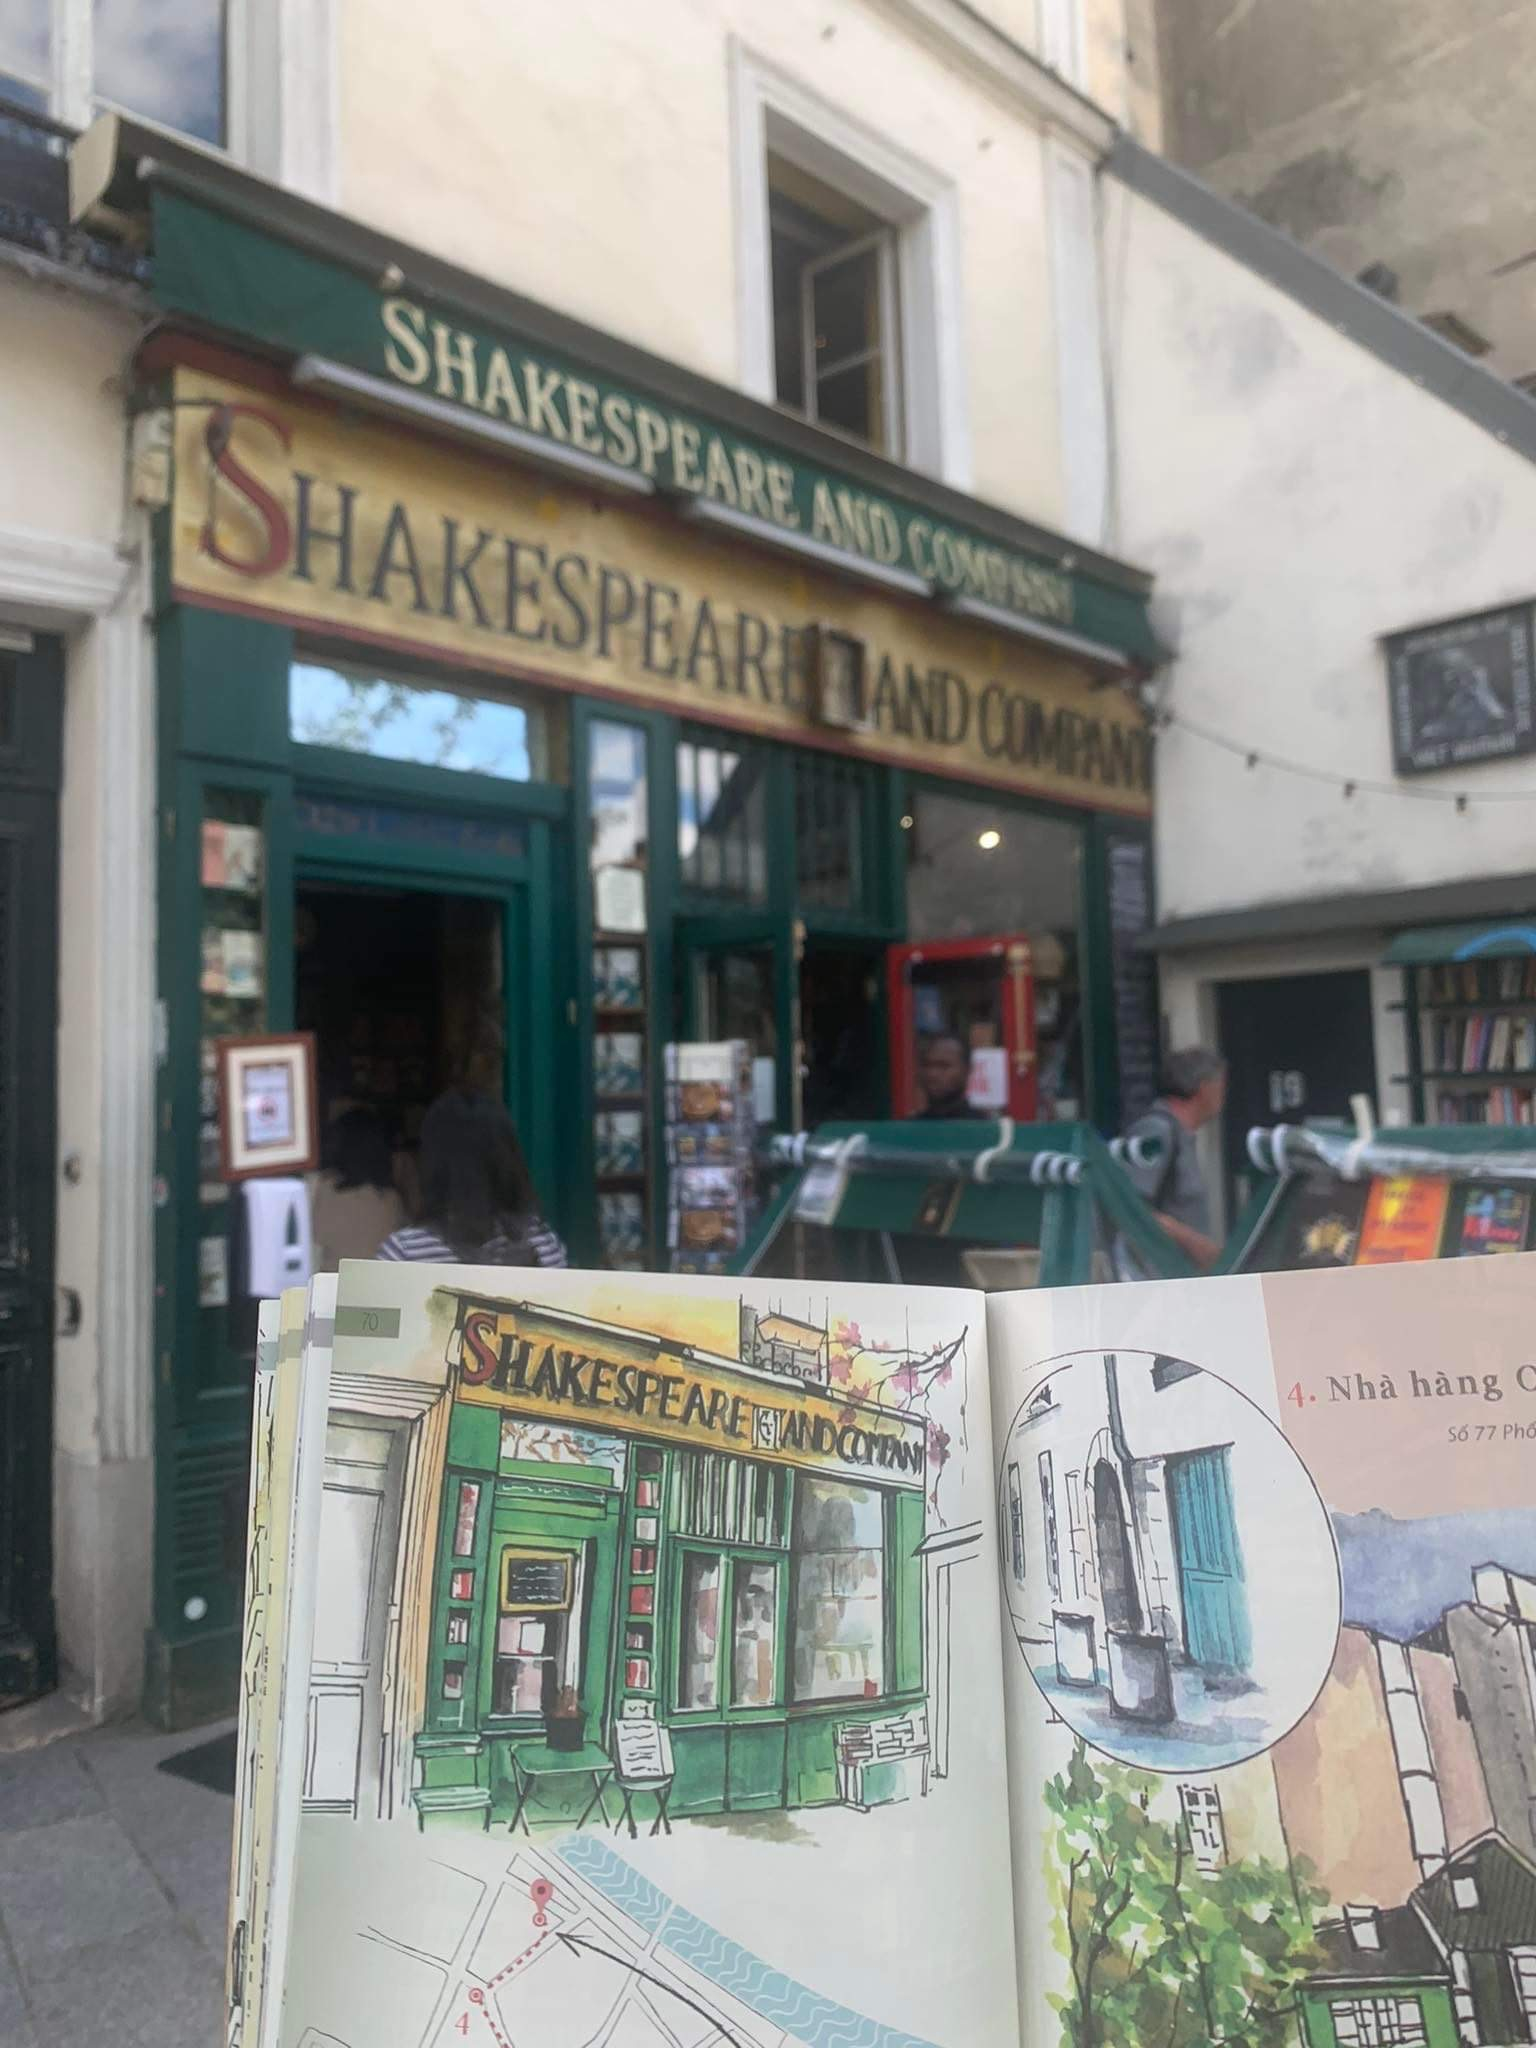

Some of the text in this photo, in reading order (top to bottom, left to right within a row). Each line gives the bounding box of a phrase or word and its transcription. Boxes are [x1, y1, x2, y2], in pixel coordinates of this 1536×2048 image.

[382, 299, 800, 528] SHAKESPEARE
[812, 480, 901, 565] AND
[198, 404, 804, 713] SHAKESPEARE
[872, 650, 970, 747] AND
[362, 1312, 379, 1332] 70
[463, 1312, 751, 1440] SHAKESPEARE
[779, 1407, 838, 1455] AND
[1287, 1382, 1316, 1408] 4.
[1326, 1373, 1398, 1402] Nhà
[1408, 1370, 1503, 1402] hàng
[1448, 1424, 1469, 1443] Số
[1474, 1425, 1497, 1442] 77
[454, 2011, 470, 2036] 4
